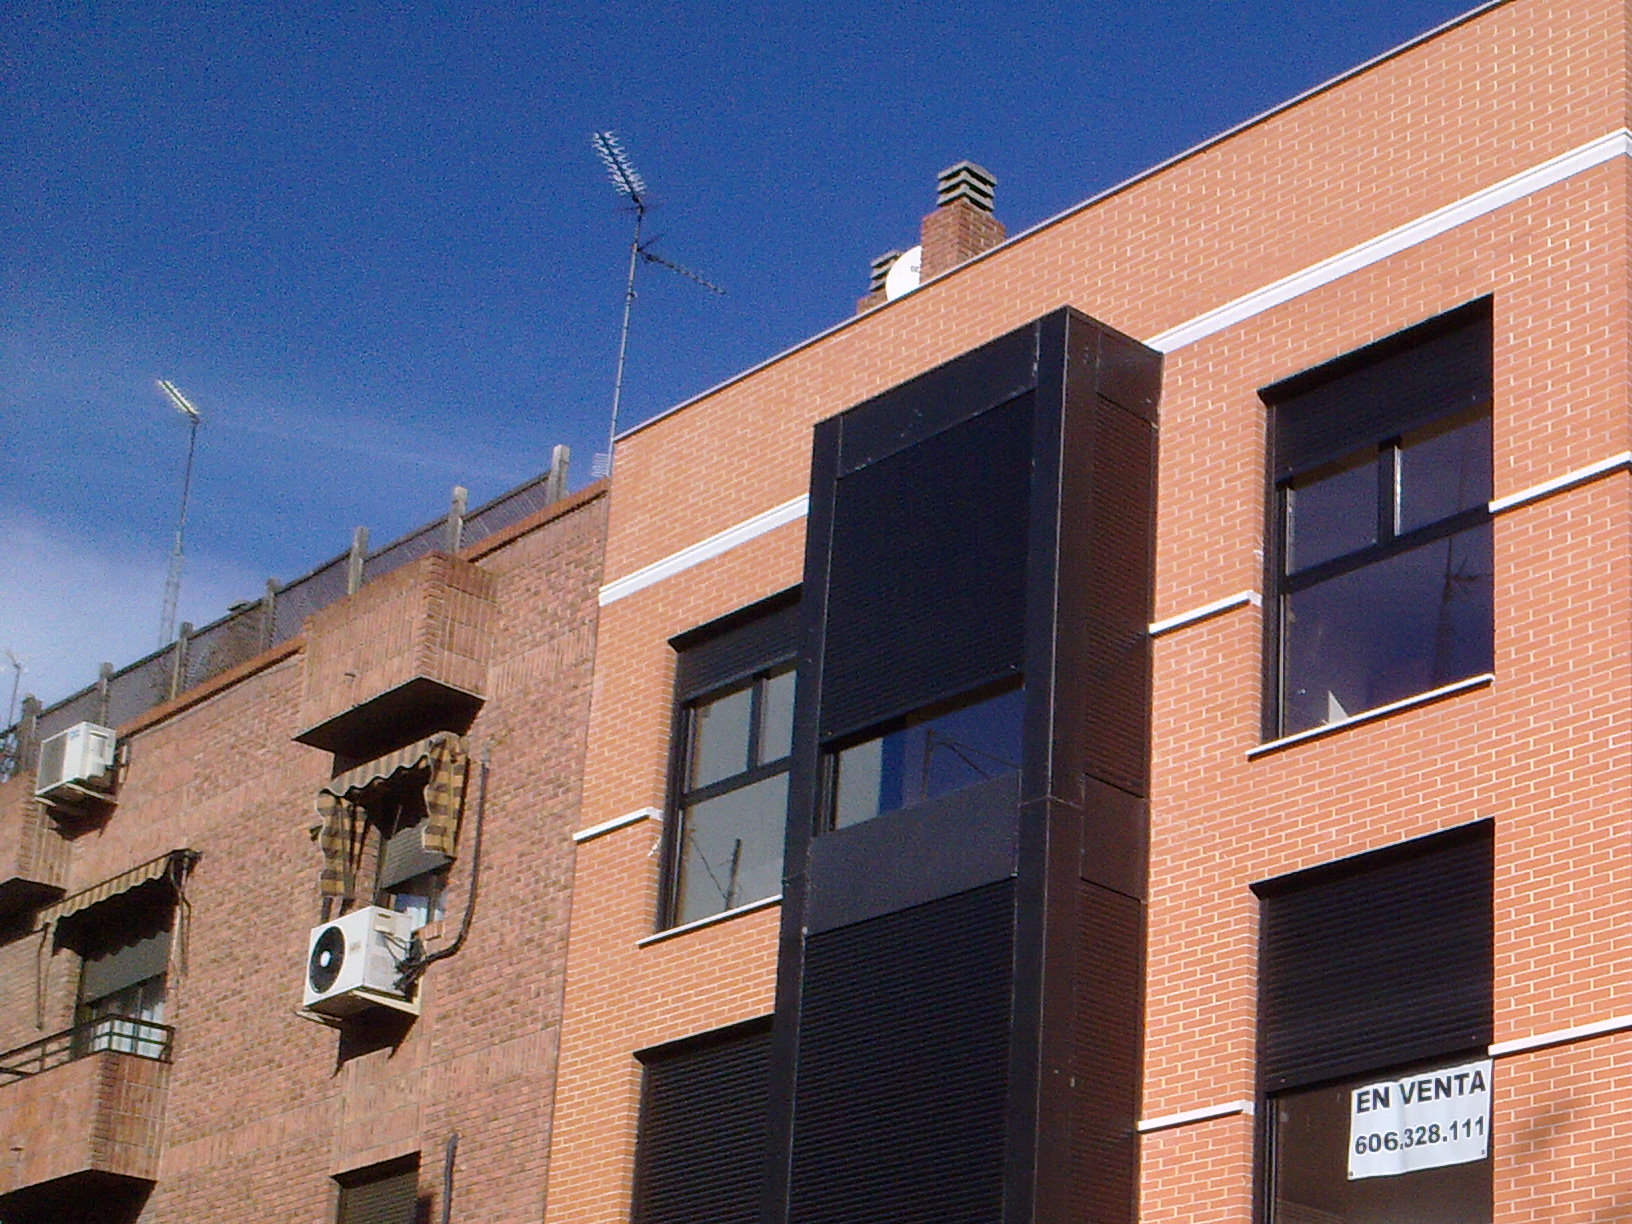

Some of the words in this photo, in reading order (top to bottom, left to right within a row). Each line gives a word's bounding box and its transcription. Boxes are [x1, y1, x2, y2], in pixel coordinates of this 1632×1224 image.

[1356, 1085, 1391, 1114] EN
[1400, 1070, 1487, 1105] VENTA
[1354, 1115, 1486, 1155] 606.328.111
